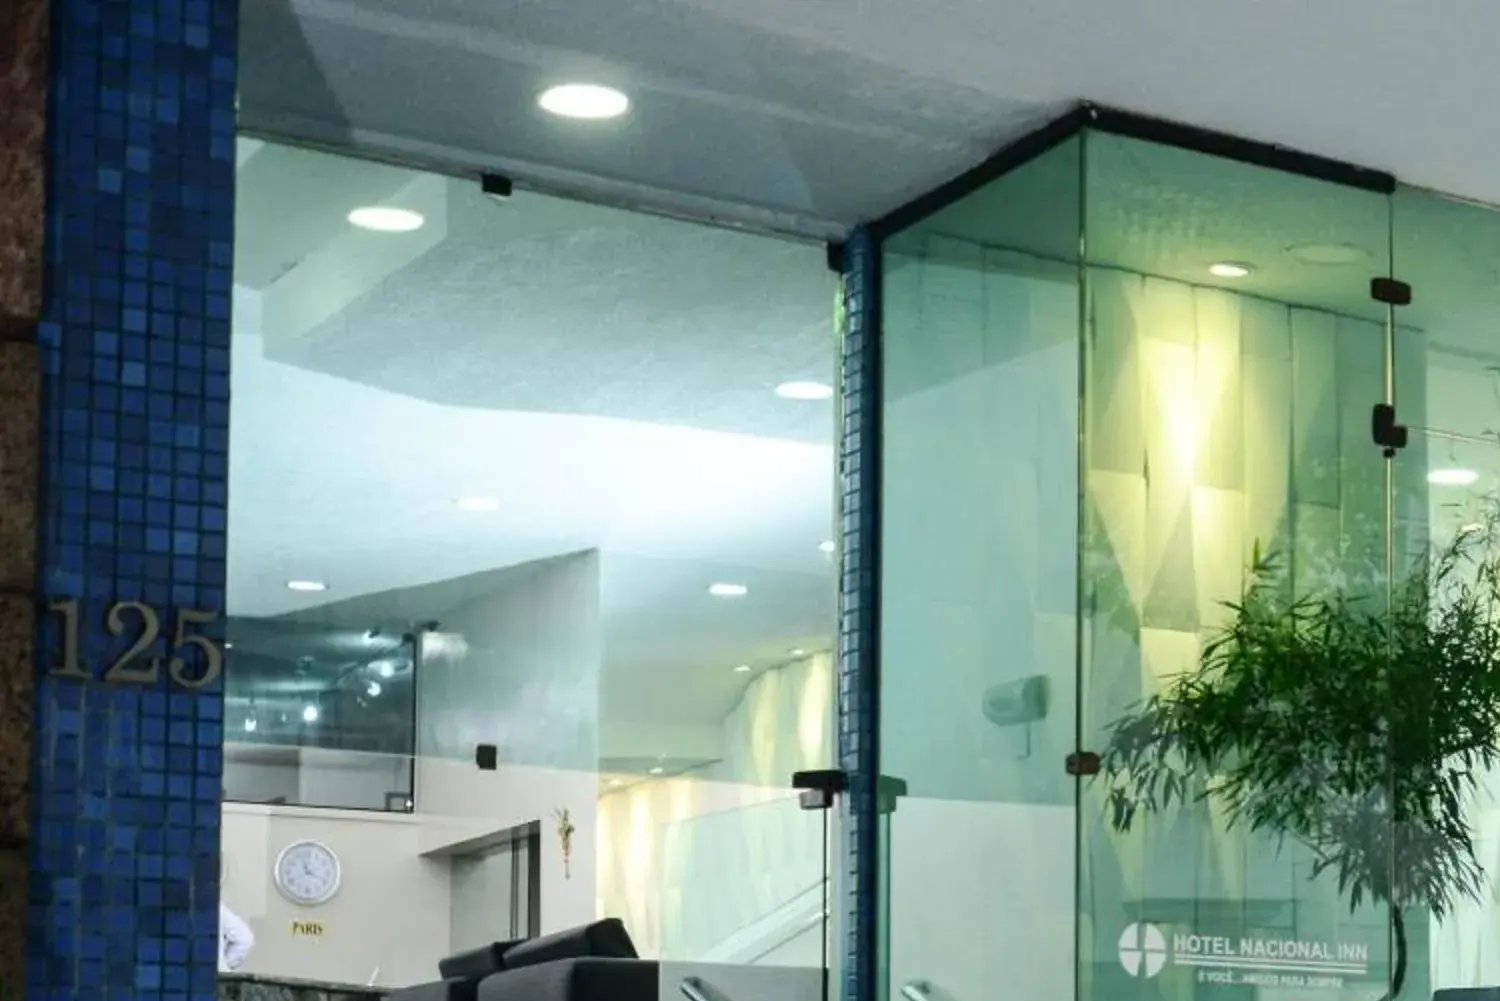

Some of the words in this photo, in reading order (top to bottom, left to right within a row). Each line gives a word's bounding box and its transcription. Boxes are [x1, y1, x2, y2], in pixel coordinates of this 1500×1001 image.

[49, 599, 222, 688] 125
[293, 921, 323, 935] PARIS
[1173, 933, 1234, 955] HOTEL
[1240, 937, 1333, 959] NACIONAL
[1338, 943, 1367, 961] INN
